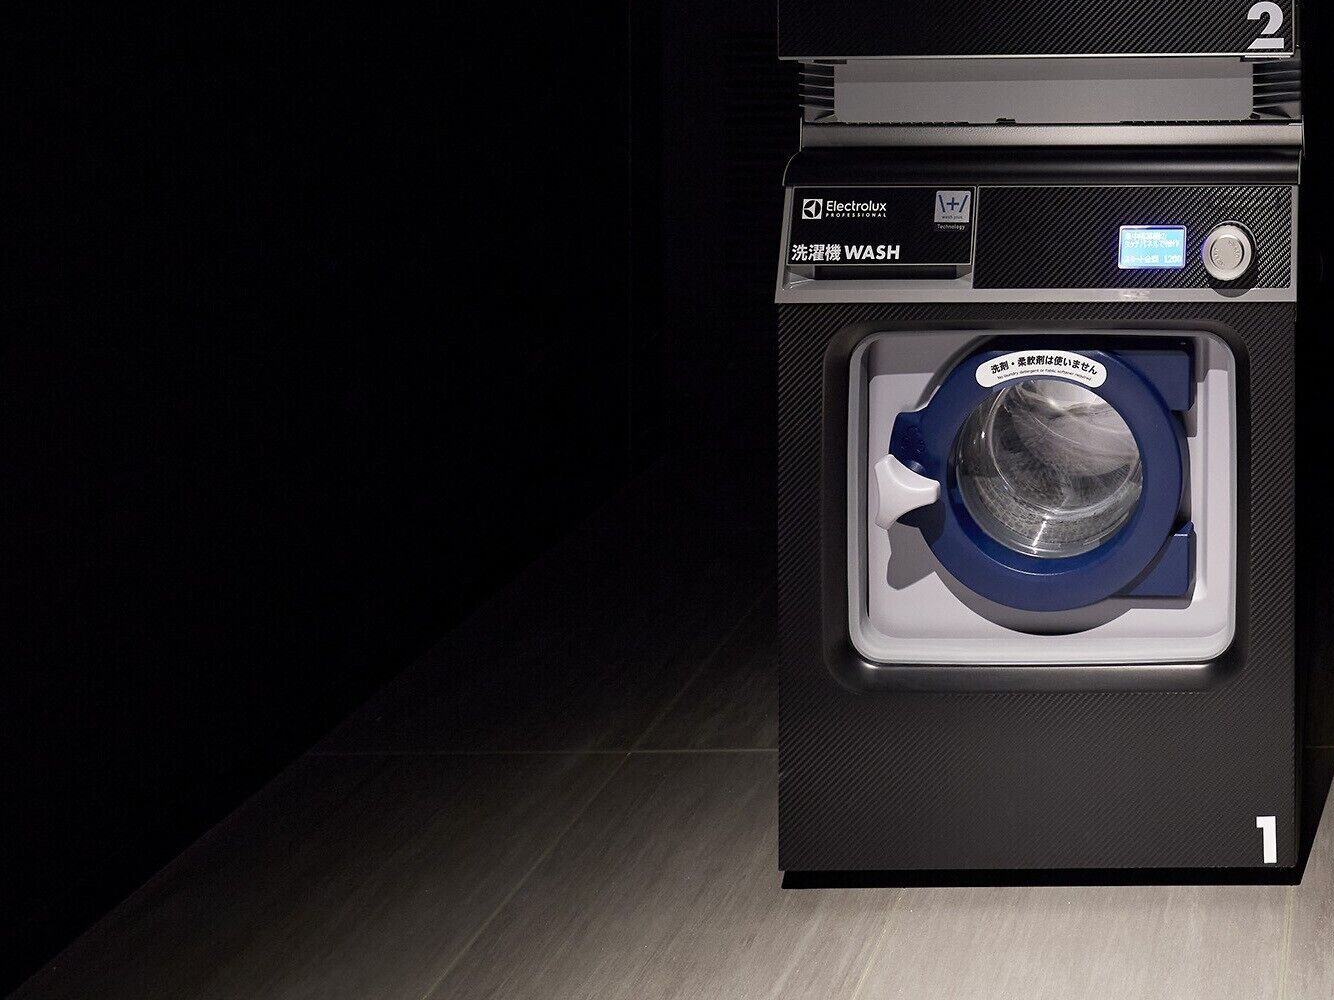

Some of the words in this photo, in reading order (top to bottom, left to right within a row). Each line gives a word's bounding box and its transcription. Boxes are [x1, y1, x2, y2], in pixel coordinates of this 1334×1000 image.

[1247, 1, 1284, 49] 2
[826, 200, 887, 212] Electrolux
[791, 244, 842, 261] 洗濯機
[844, 245, 900, 260] WASH
[1256, 816, 1277, 864] 1
